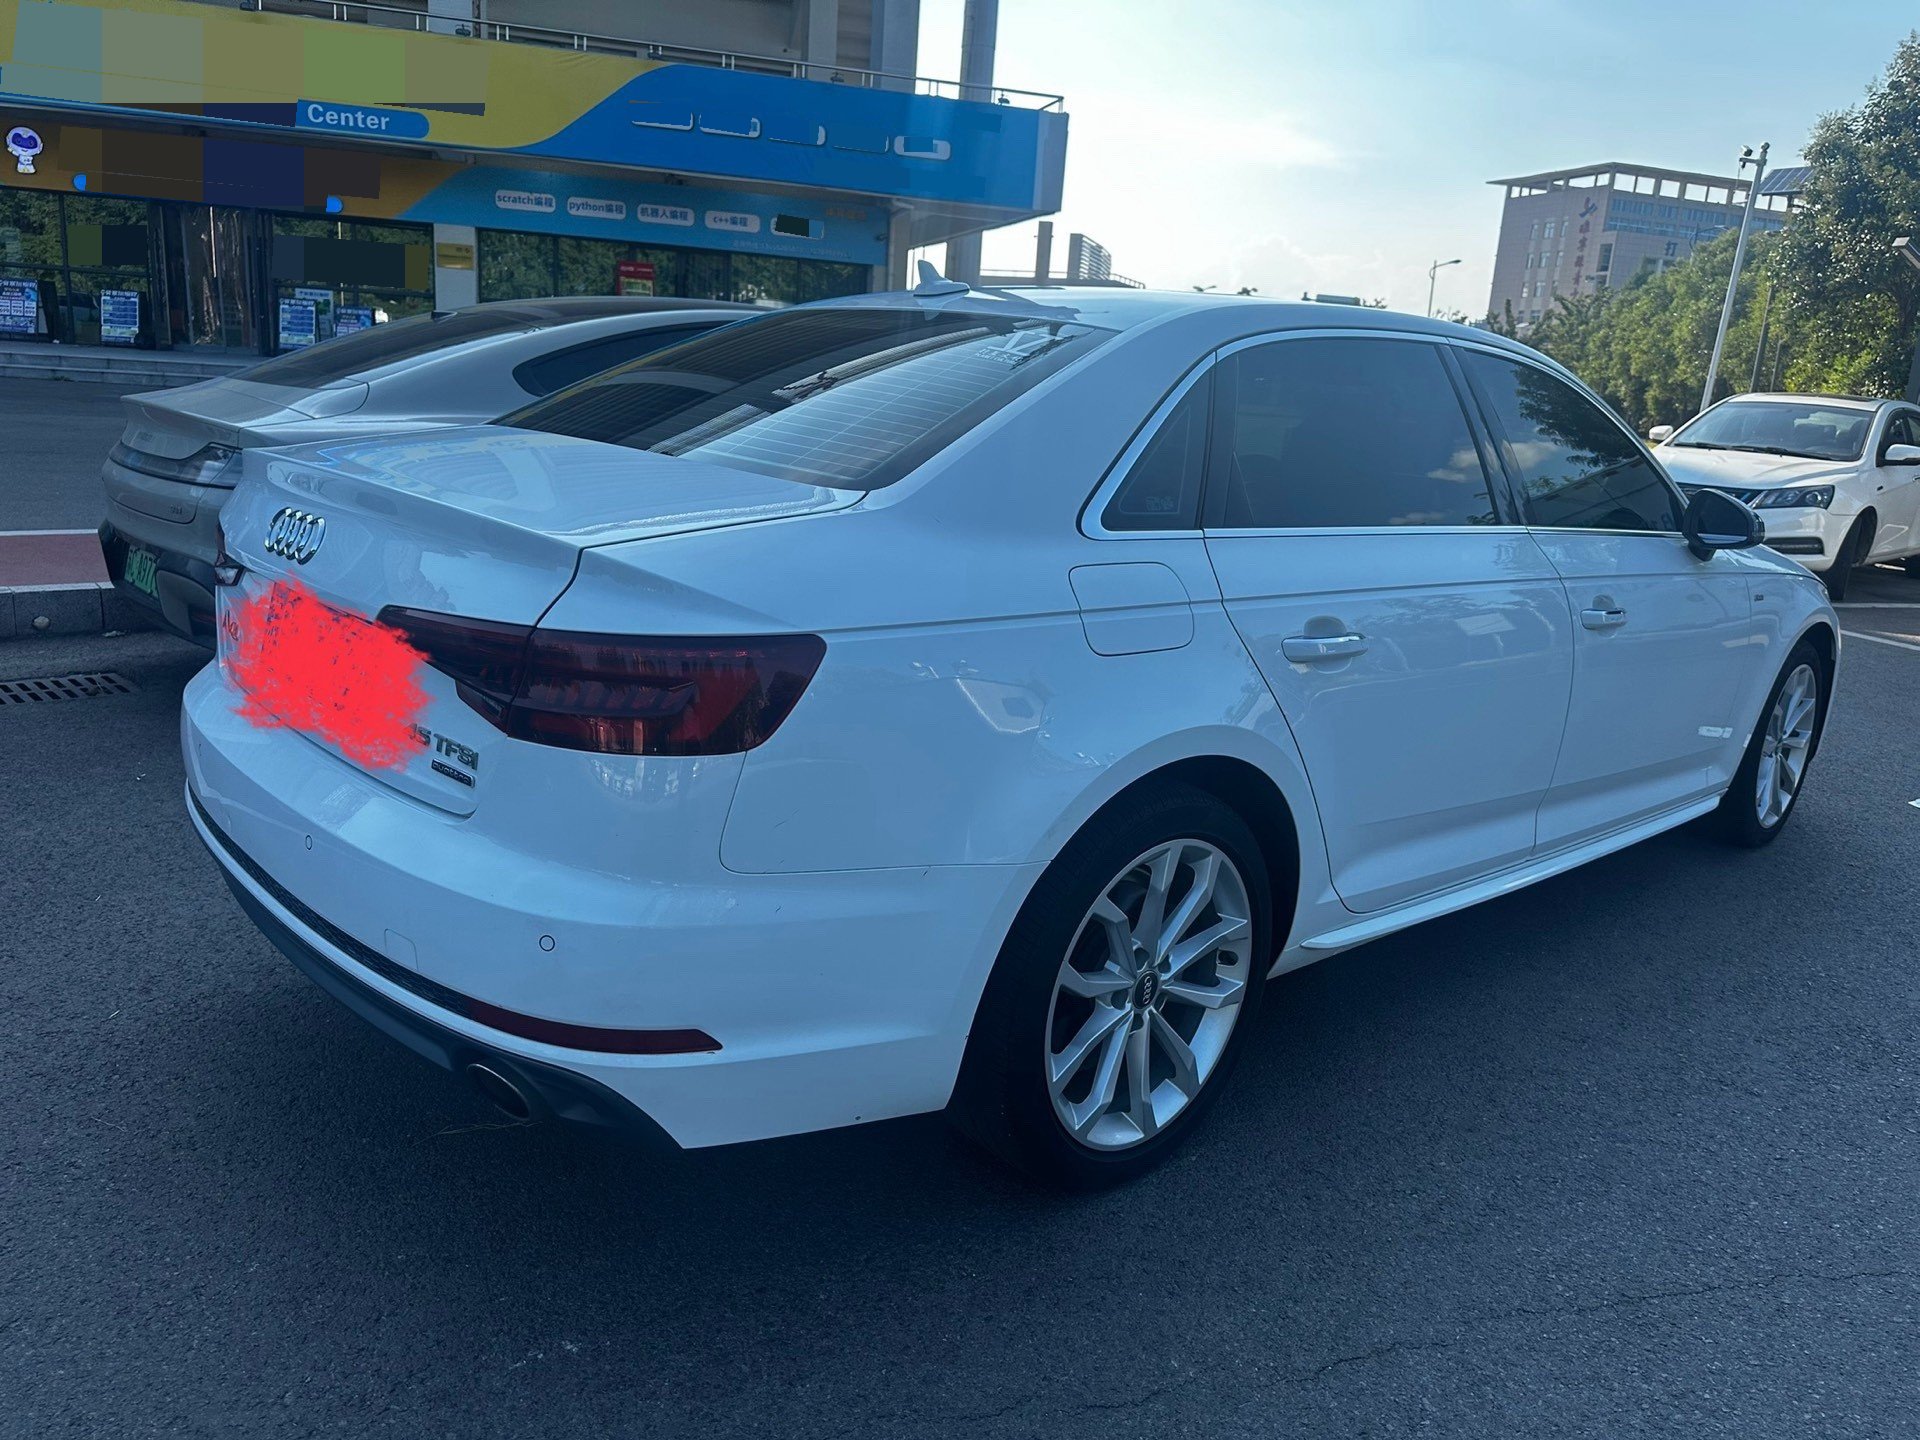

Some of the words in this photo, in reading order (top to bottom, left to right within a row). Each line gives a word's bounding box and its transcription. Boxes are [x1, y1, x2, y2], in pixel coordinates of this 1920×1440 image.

[307, 103, 390, 131] Center
[569, 201, 625, 215] python编程
[640, 206, 689, 221] 机器人编程
[433, 733, 479, 771] TFSI
